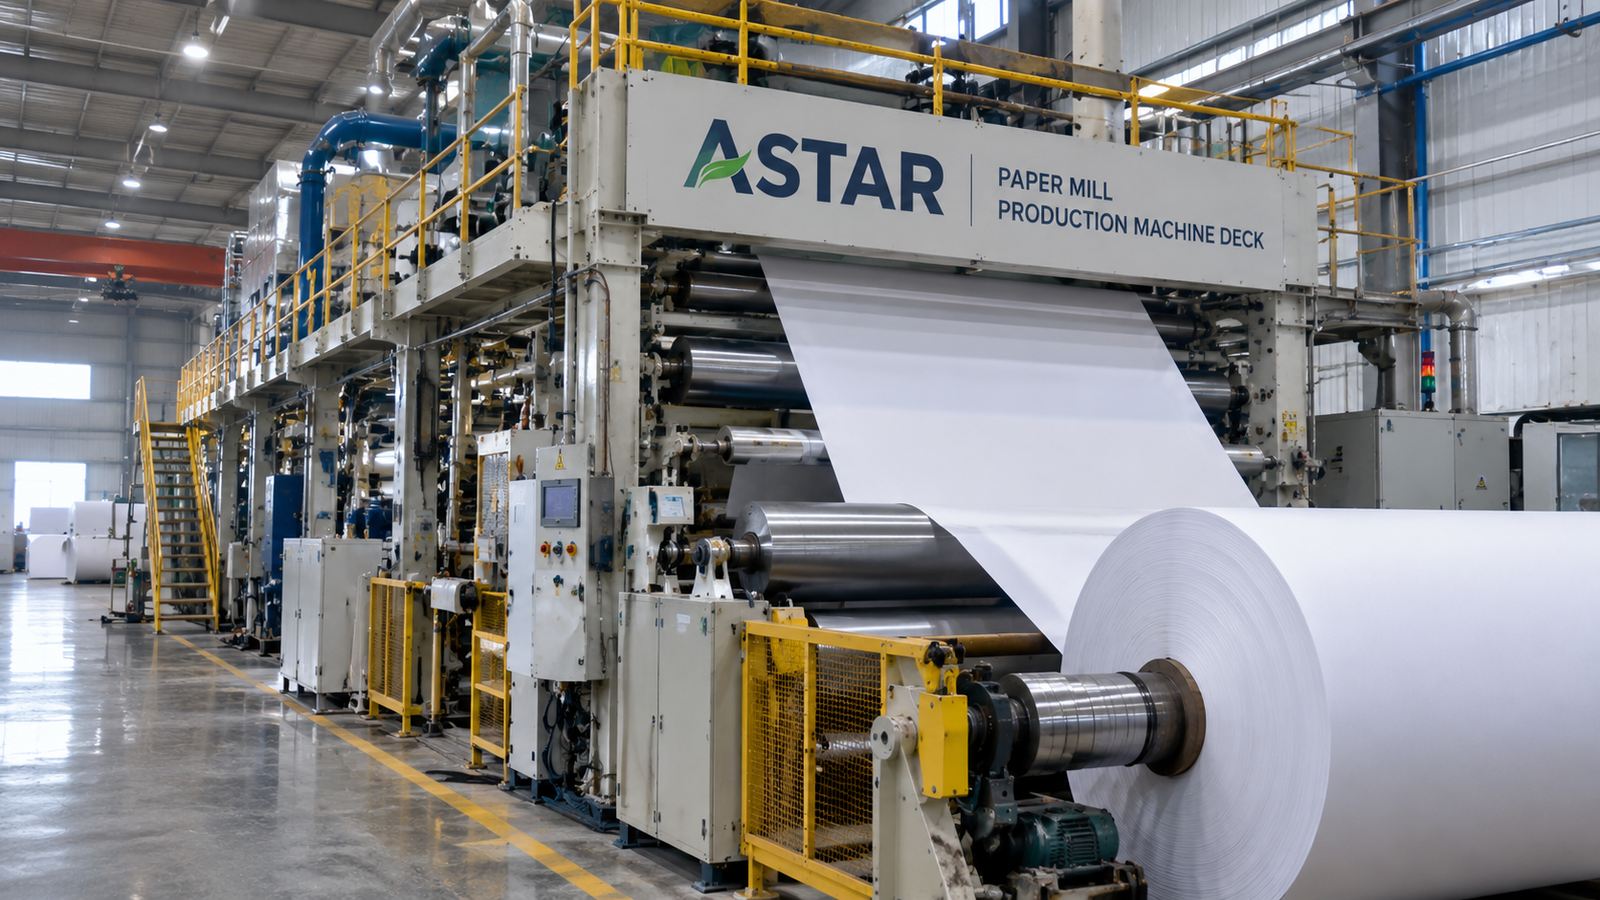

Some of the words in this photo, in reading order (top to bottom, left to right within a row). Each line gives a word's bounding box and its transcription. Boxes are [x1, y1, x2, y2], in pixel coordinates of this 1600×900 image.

[682, 117, 945, 216] ASTAR
[998, 166, 1064, 197] PAPER
[1069, 176, 1114, 202] MILL
[998, 199, 1128, 235] PRODUCTION
[1133, 216, 1216, 245] MACHINE
[1219, 226, 1265, 251] DECK
